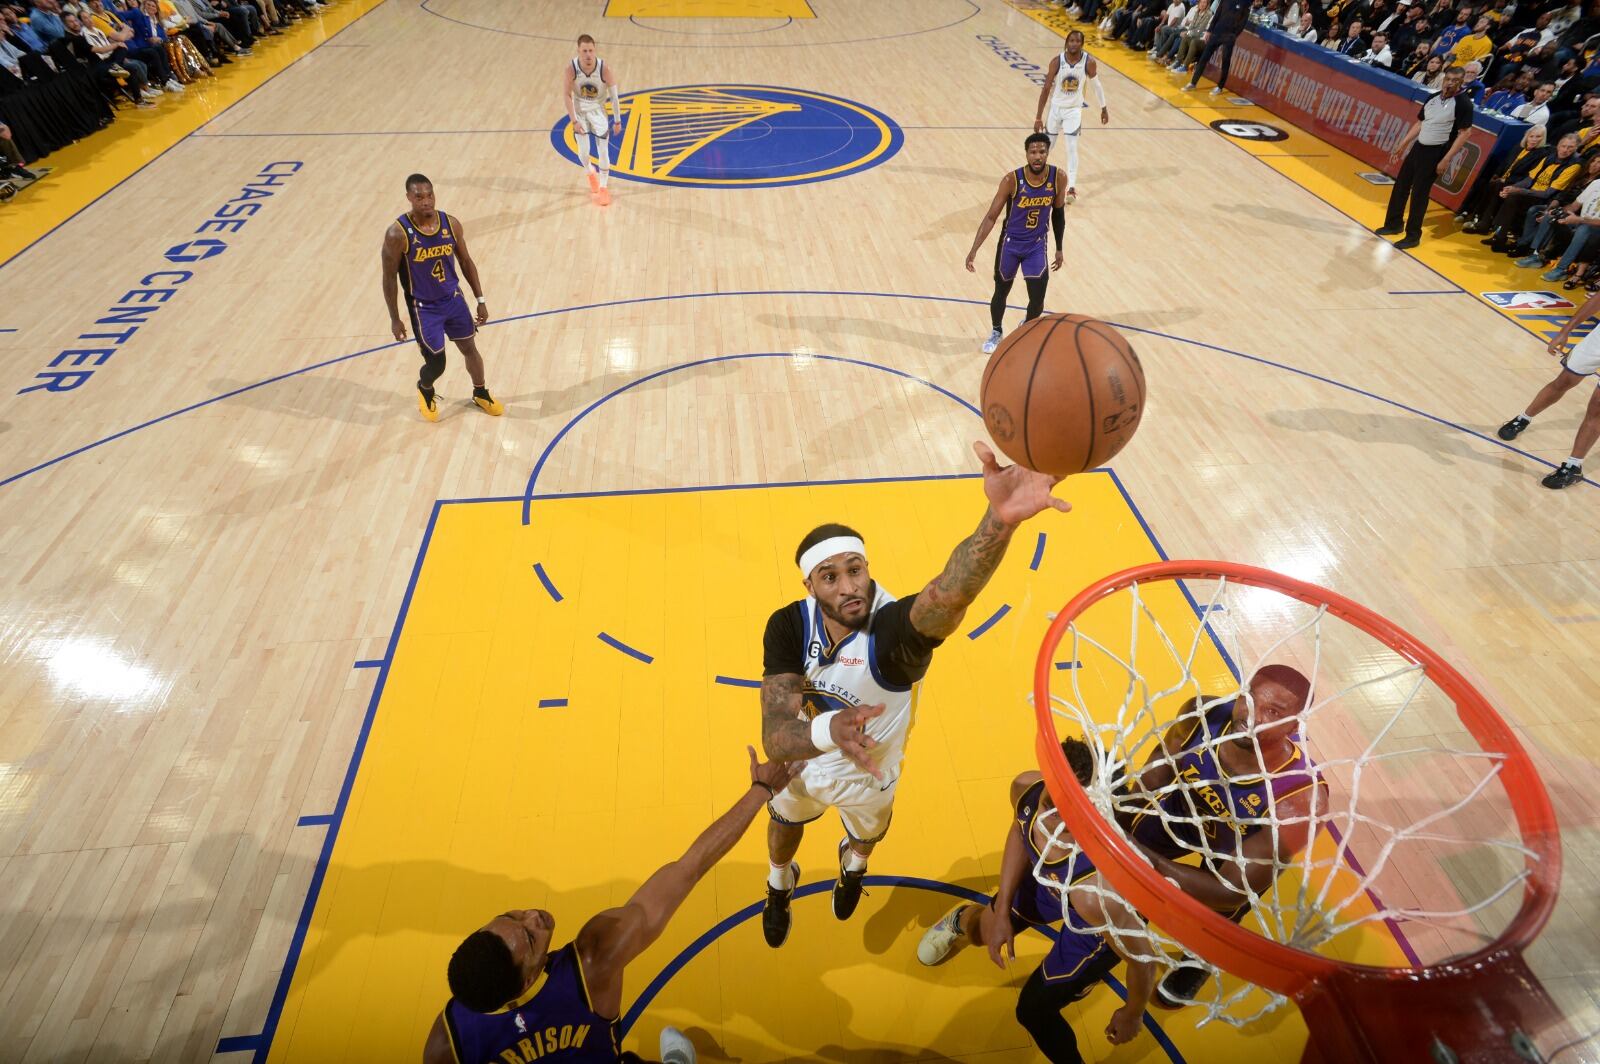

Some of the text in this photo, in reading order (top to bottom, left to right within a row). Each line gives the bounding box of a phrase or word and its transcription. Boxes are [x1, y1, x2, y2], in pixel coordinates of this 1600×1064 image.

[1246, 53, 1292, 98] PLAYOFF
[1285, 71, 1324, 114] MODE
[1316, 84, 1353, 129] WITH
[1348, 98, 1383, 143] THE
[1220, 124, 1279, 137] 6
[1017, 195, 1053, 208] LAKERS
[1025, 209, 1040, 229] 5
[414, 243, 453, 262] LAKERS
[16, 161, 304, 395] CHASE CENTER
[431, 259, 446, 283] 4
[808, 640, 822, 659] 6
[839, 656, 865, 667] Rakuten
[830, 684, 862, 705] STATE
[1239, 797, 1257, 817] bibigo
